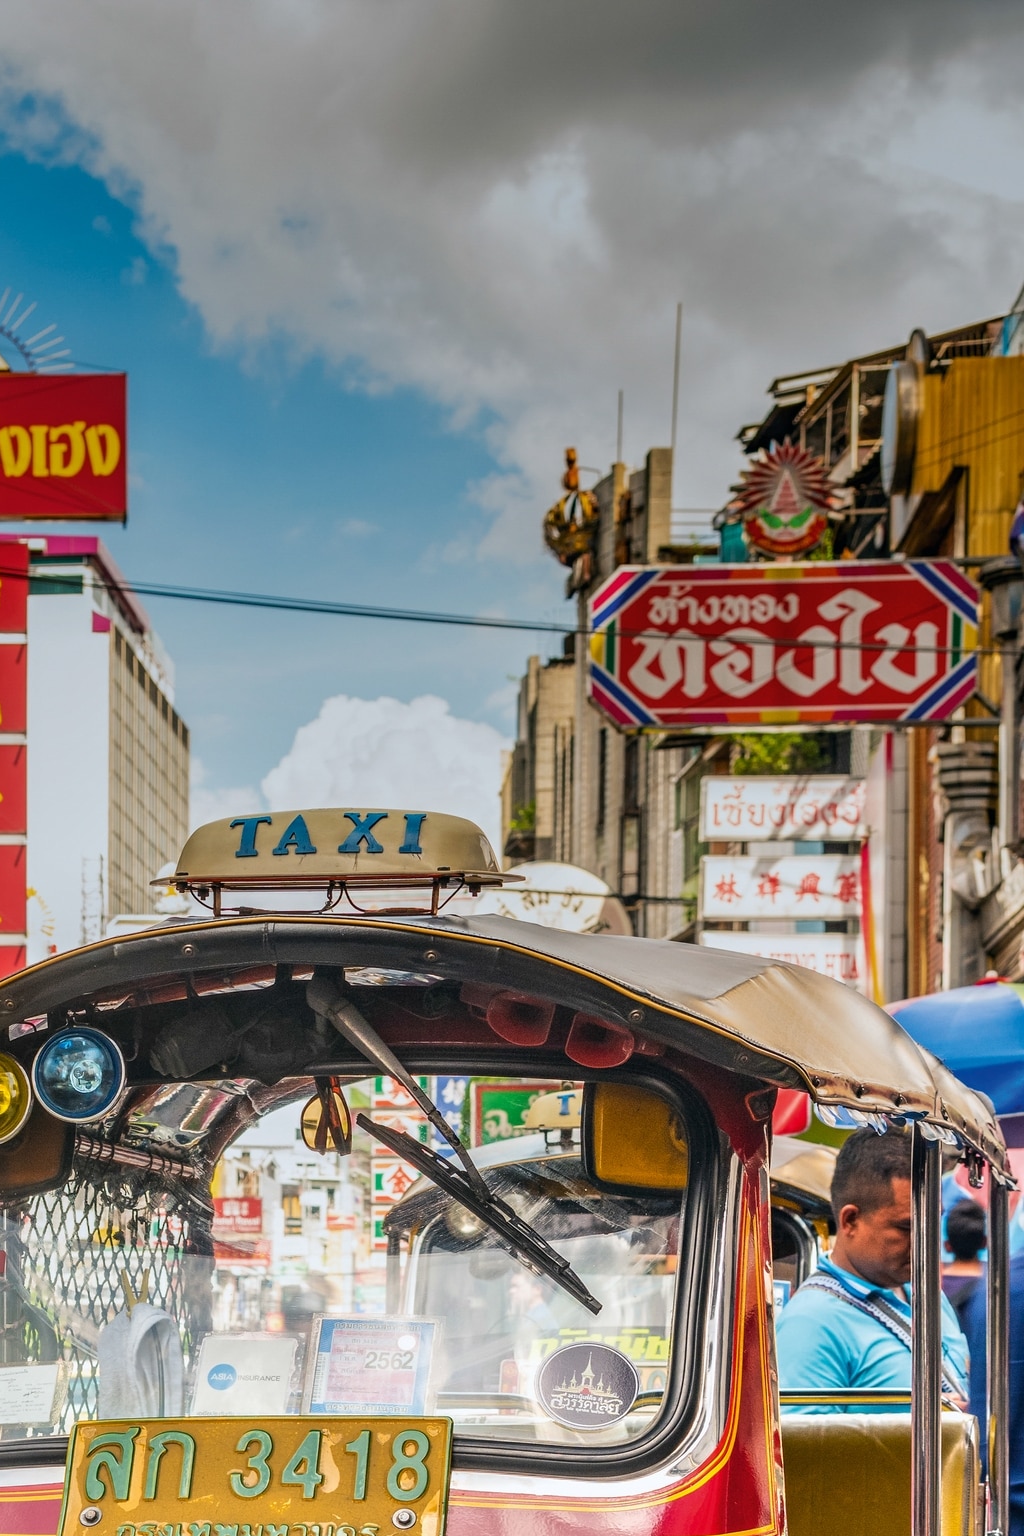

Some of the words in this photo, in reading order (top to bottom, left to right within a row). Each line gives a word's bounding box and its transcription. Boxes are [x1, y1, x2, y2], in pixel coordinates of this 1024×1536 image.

[647, 585, 800, 626] ห้างทอง
[229, 812, 427, 858] TAXI
[557, 1094, 582, 1117] T
[364, 1351, 414, 1370] 2562
[85, 1426, 196, 1501] สก
[228, 1428, 430, 1502] 3418
